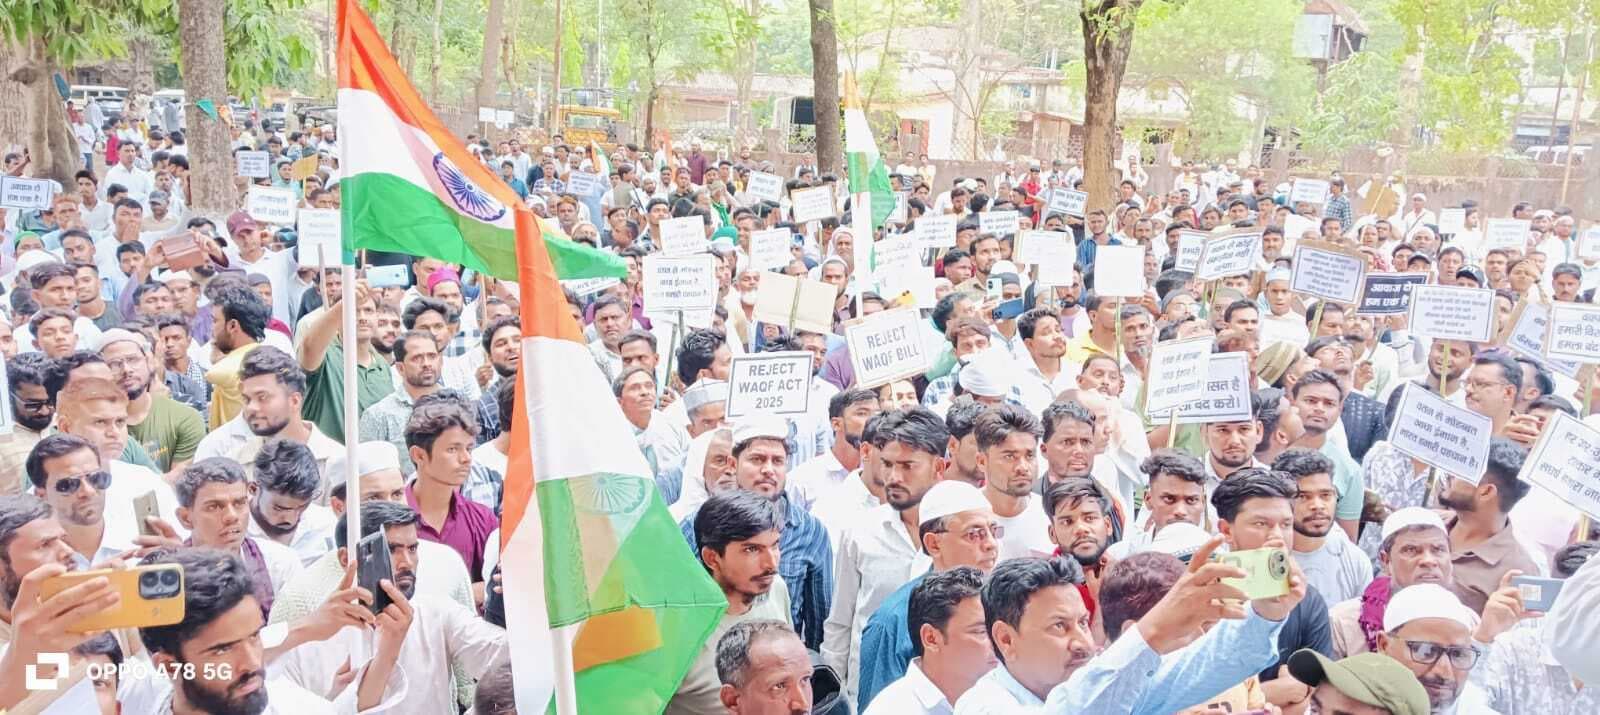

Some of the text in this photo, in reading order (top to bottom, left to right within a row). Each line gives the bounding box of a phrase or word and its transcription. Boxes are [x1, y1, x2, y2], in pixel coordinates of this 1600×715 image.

[1370, 284, 1402, 292] आवाज
[1365, 297, 1381, 306] हम
[1382, 297, 1400, 306] एक
[1558, 324, 1582, 336] हमारी
[866, 326, 906, 350] REJECT
[862, 344, 920, 372] WAQF BILL
[748, 362, 796, 376] REJECT
[739, 378, 802, 393] WAQF ACT
[1232, 376, 1240, 392] है
[755, 396, 783, 409] 2025
[1434, 410, 1444, 422] से
[1414, 418, 1432, 433] आधा
[1399, 428, 1417, 442] भारत
[1418, 437, 1440, 452] हमारी
[1440, 446, 1468, 464] पहचान
